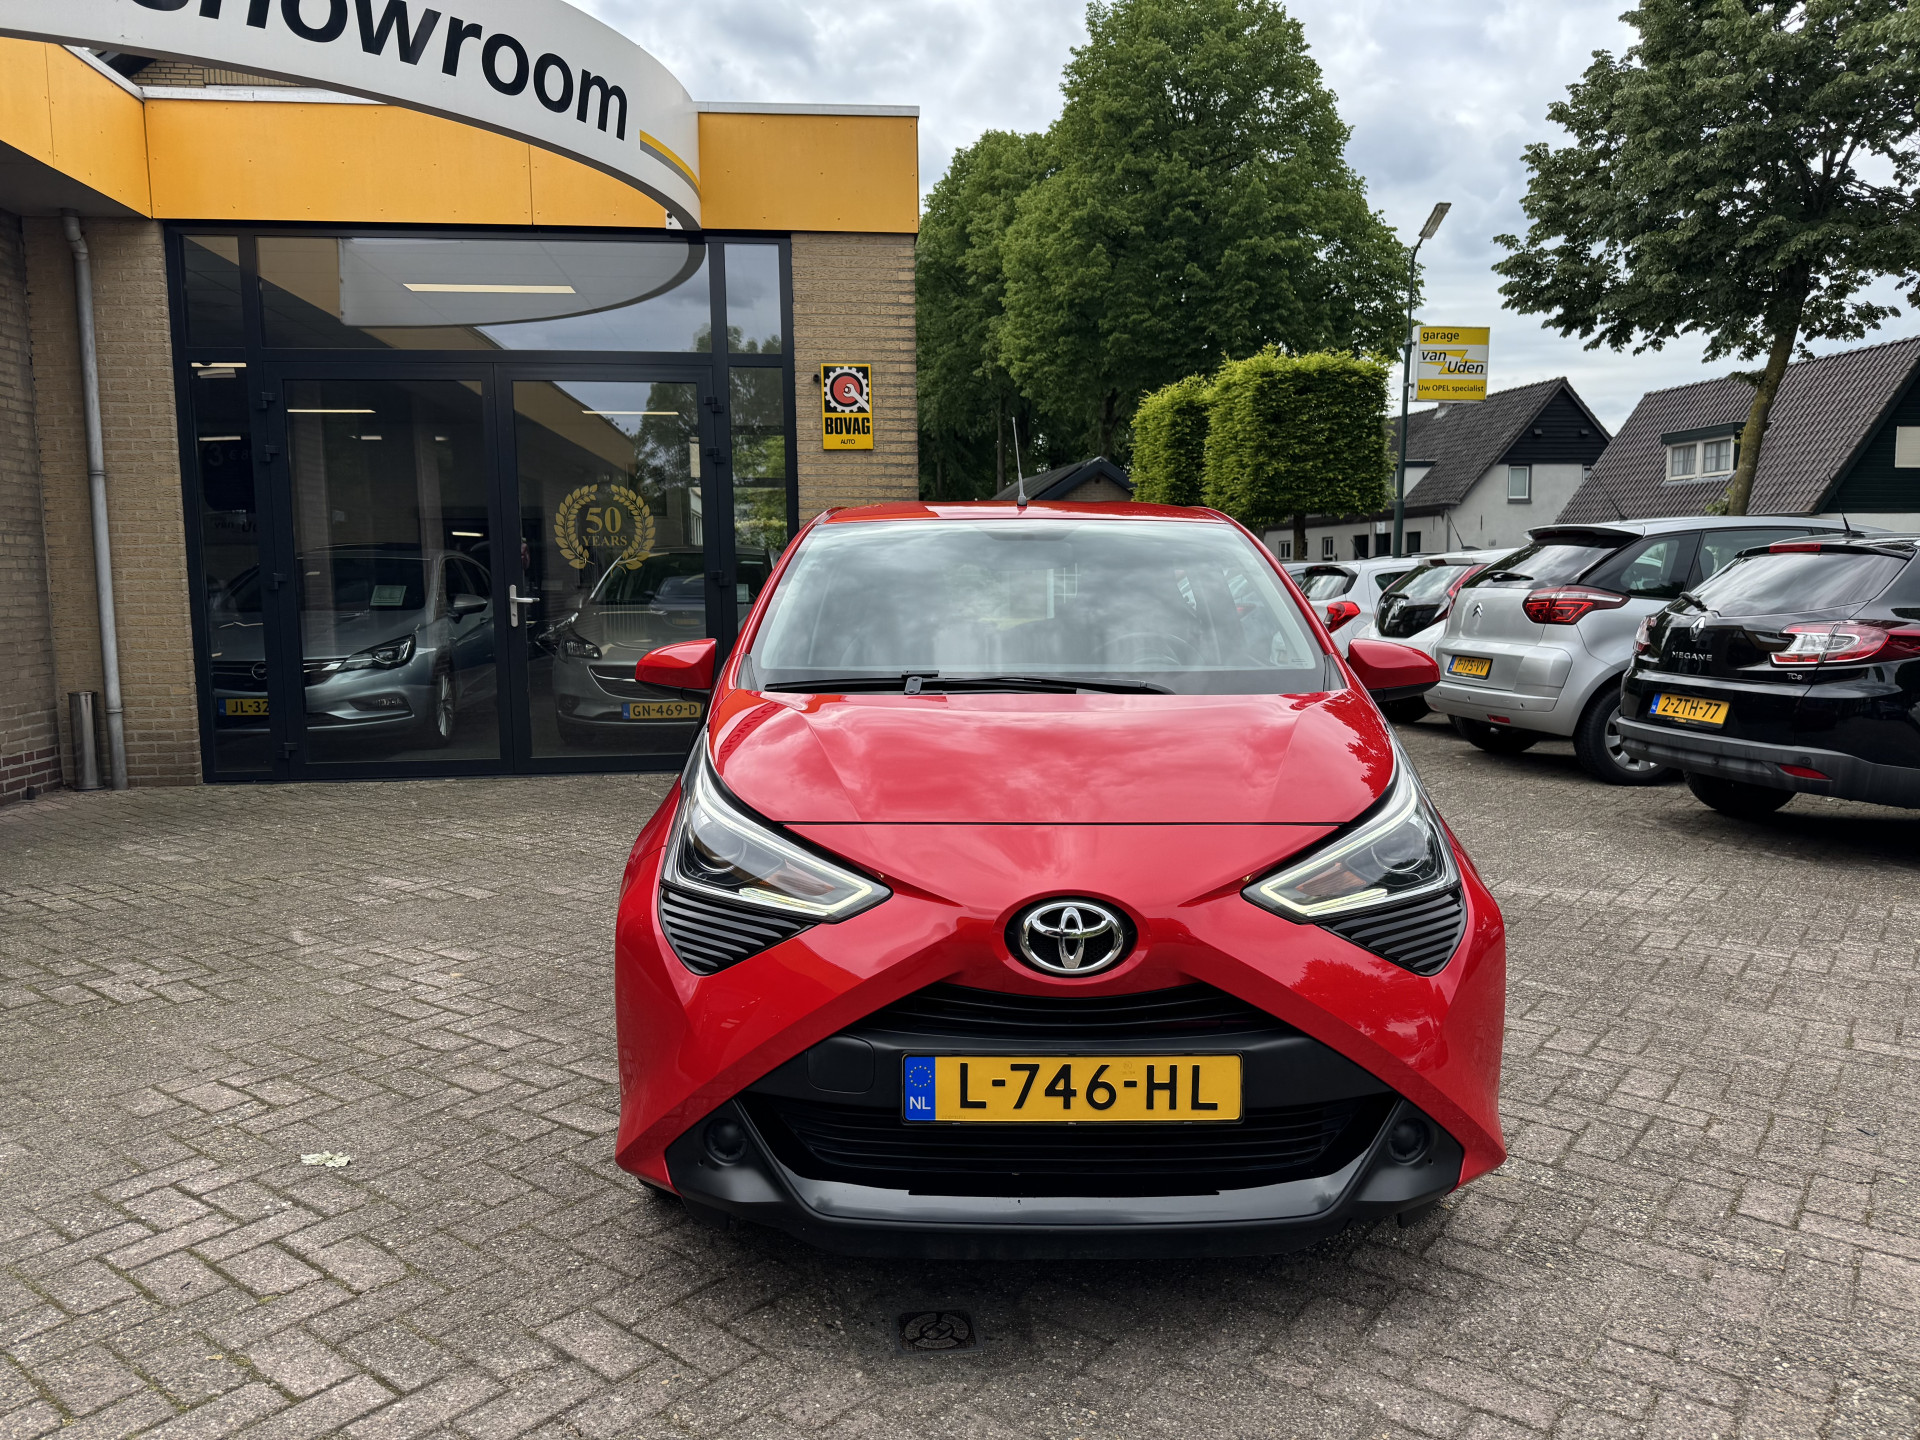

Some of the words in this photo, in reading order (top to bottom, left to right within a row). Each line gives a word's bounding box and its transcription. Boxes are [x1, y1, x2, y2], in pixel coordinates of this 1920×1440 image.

[1422, 331, 1460, 342] garage
[1422, 351, 1447, 361] van
[1447, 360, 1484, 374] Uden
[1451, 385, 1484, 393] specialist
[825, 417, 871, 435] BOVAG
[586, 506, 622, 534] 50
[582, 535, 628, 546] YEARS
[632, 704, 698, 717] GN-469-D
[1661, 696, 1722, 719] 2-ZTH-77
[909, 1096, 931, 1110] NL
[959, 1063, 1219, 1111] L-746-HL
